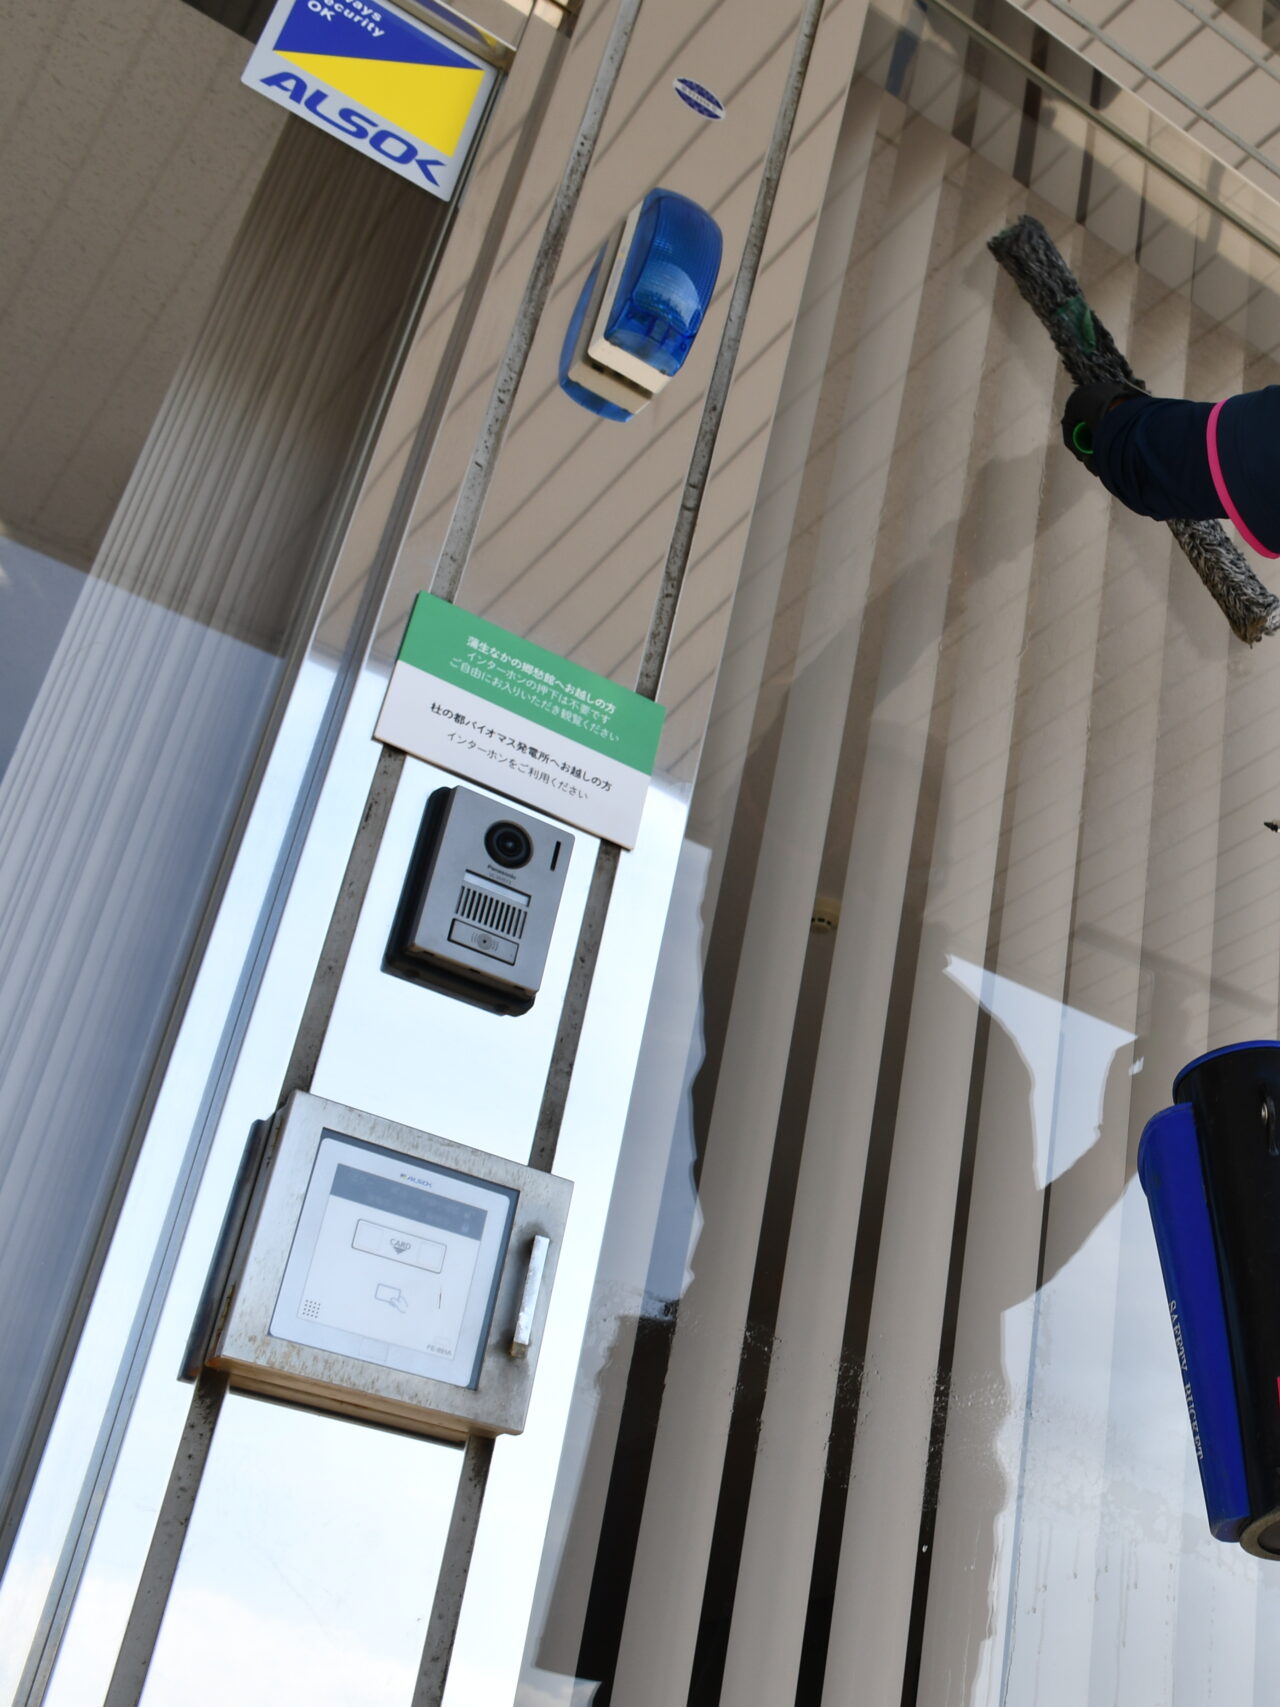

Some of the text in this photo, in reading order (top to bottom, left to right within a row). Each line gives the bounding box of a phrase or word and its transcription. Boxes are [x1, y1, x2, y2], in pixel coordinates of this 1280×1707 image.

[307, 0, 336, 22] OK
[260, 71, 447, 188] ALSOK
[449, 657, 620, 742] ご自由にお入りいただき観覧ください
[467, 651, 611, 724] インターホンの押下は不要です
[430, 702, 613, 792] 杜の都バイオマス発電所へお越しの方
[448, 732, 588, 799] インターホンをご利用ください
[390, 1239, 411, 1250] CARD
[1168, 1299, 1204, 1460] SAFETY BUCKET
